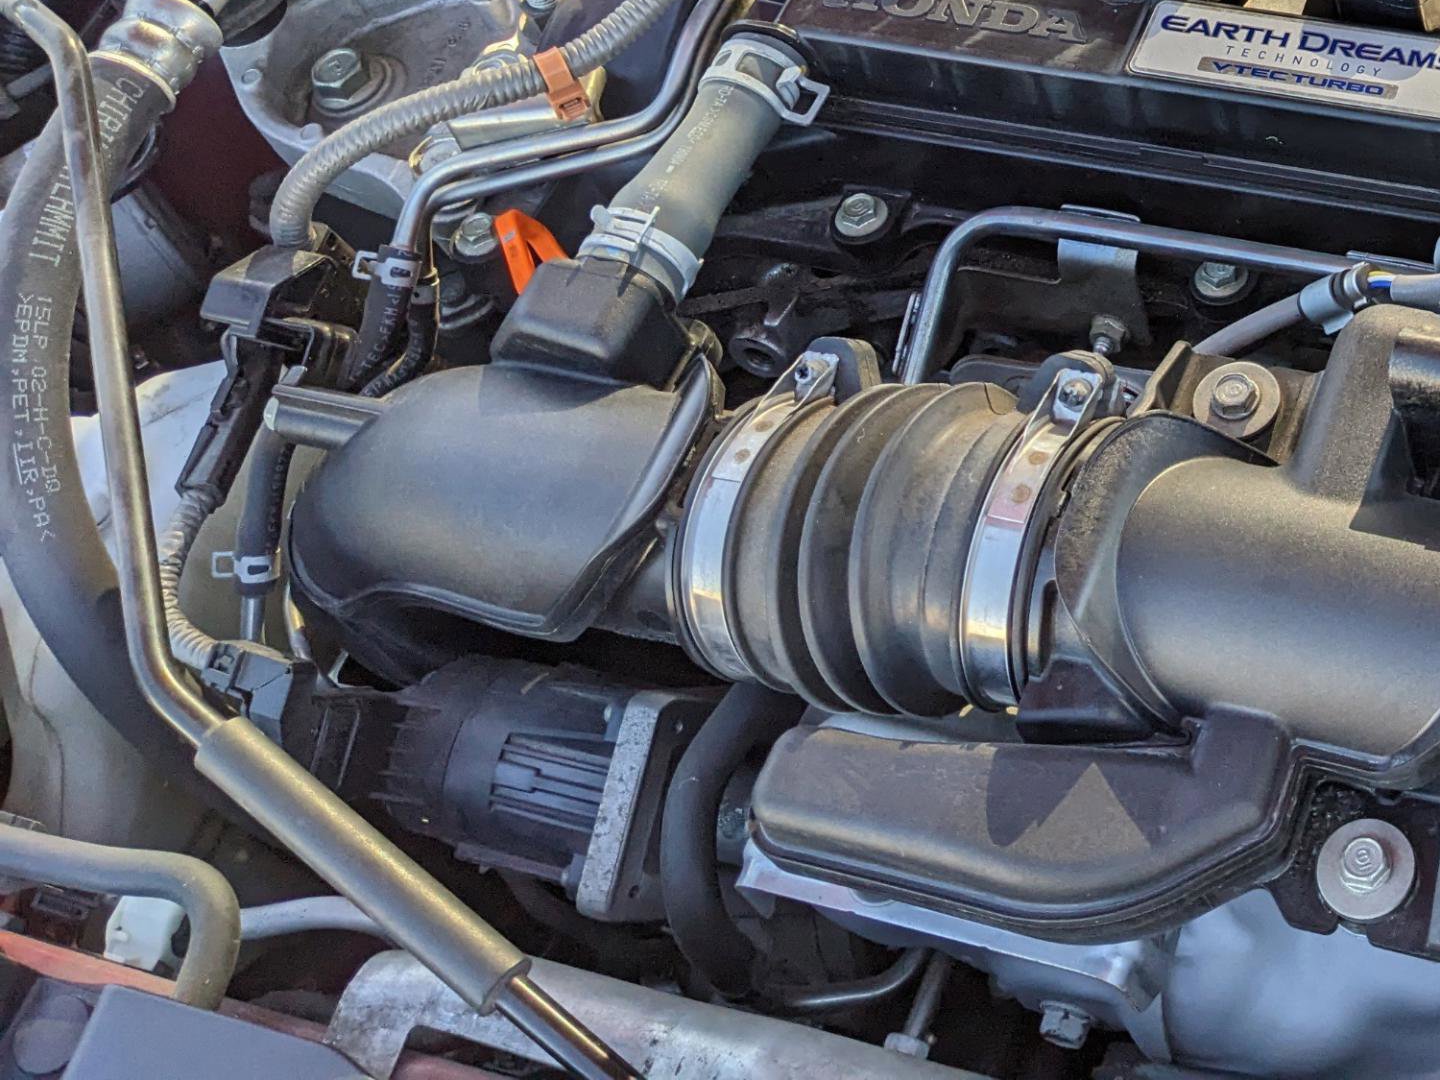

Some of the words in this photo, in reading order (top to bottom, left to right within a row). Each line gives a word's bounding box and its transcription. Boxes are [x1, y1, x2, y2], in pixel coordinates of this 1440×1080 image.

[1160, 14, 1292, 48] EARTH
[1225, 44, 1383, 78] TECHNOLOGY
[1211, 60, 1288, 82] VTEC
[1290, 72, 1385, 97] TURBO
